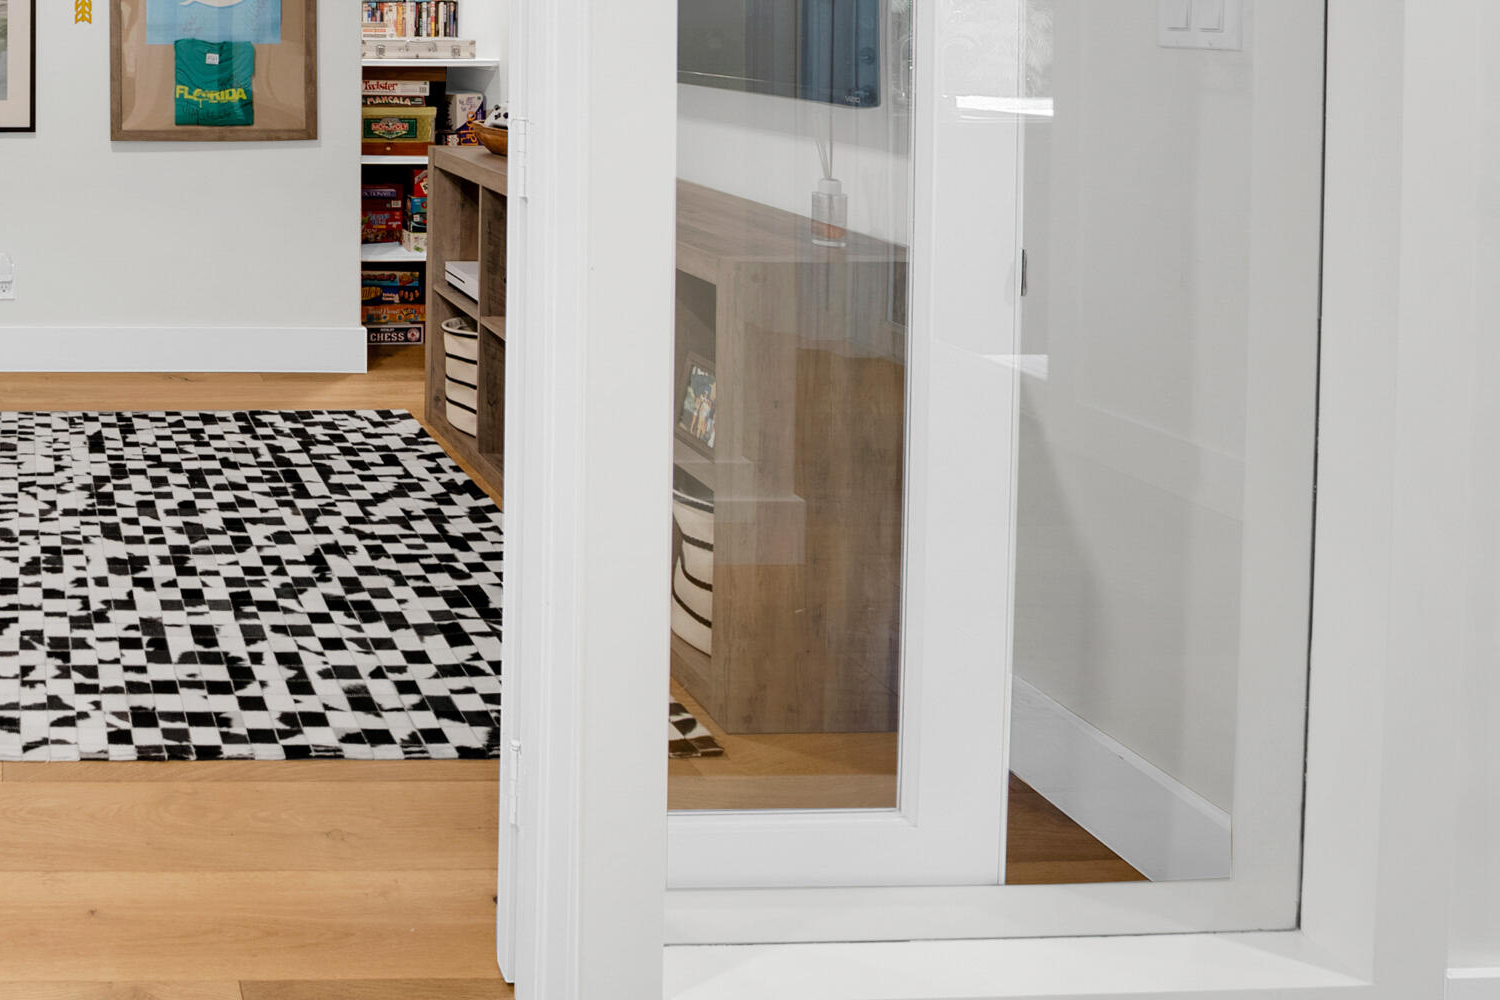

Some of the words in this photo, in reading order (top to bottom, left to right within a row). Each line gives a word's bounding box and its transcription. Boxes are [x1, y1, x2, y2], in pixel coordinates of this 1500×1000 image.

[363, 80, 398, 91] Twister
[176, 85, 247, 104] FLORIDA
[366, 96, 411, 106] MANCALA
[370, 332, 405, 342] CHESS
